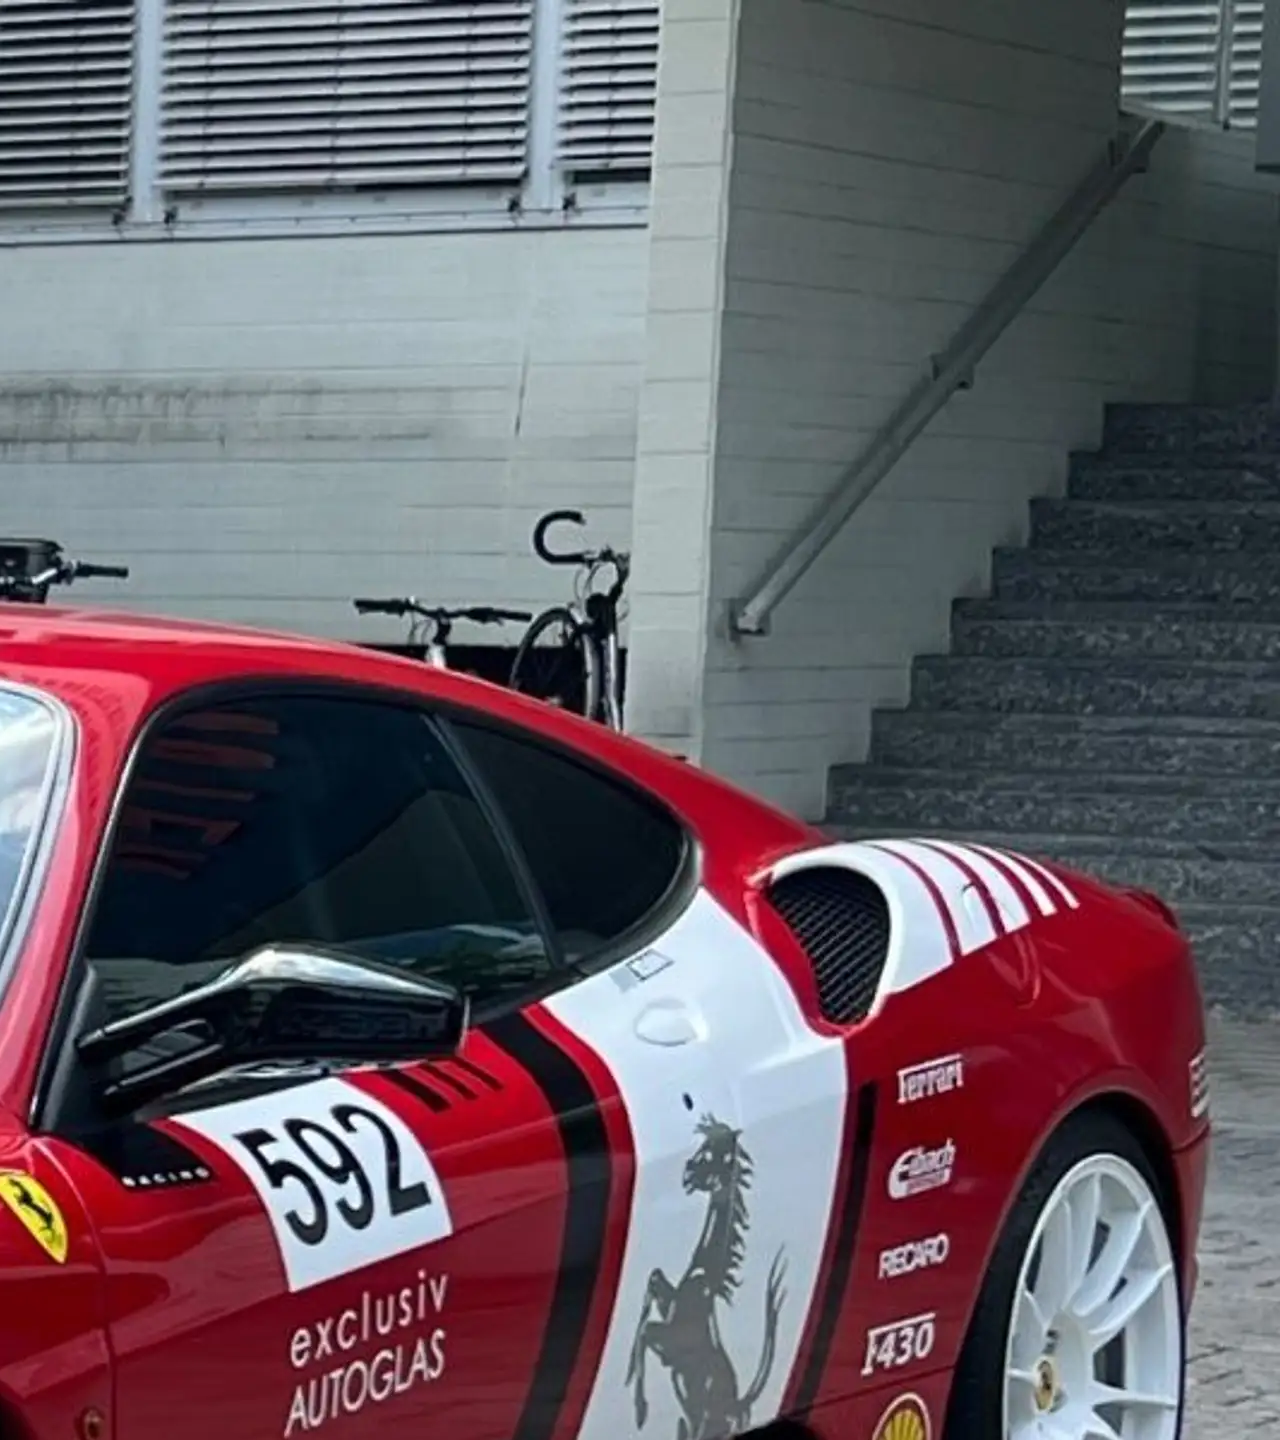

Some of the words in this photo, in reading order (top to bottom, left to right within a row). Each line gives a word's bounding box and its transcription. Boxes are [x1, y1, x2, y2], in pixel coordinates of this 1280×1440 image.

[233, 1104, 432, 1246] 592
[879, 1234, 950, 1279] RECARO
[290, 1269, 448, 1369] exclusiv
[284, 1329, 446, 1438] AUTOGLAS
